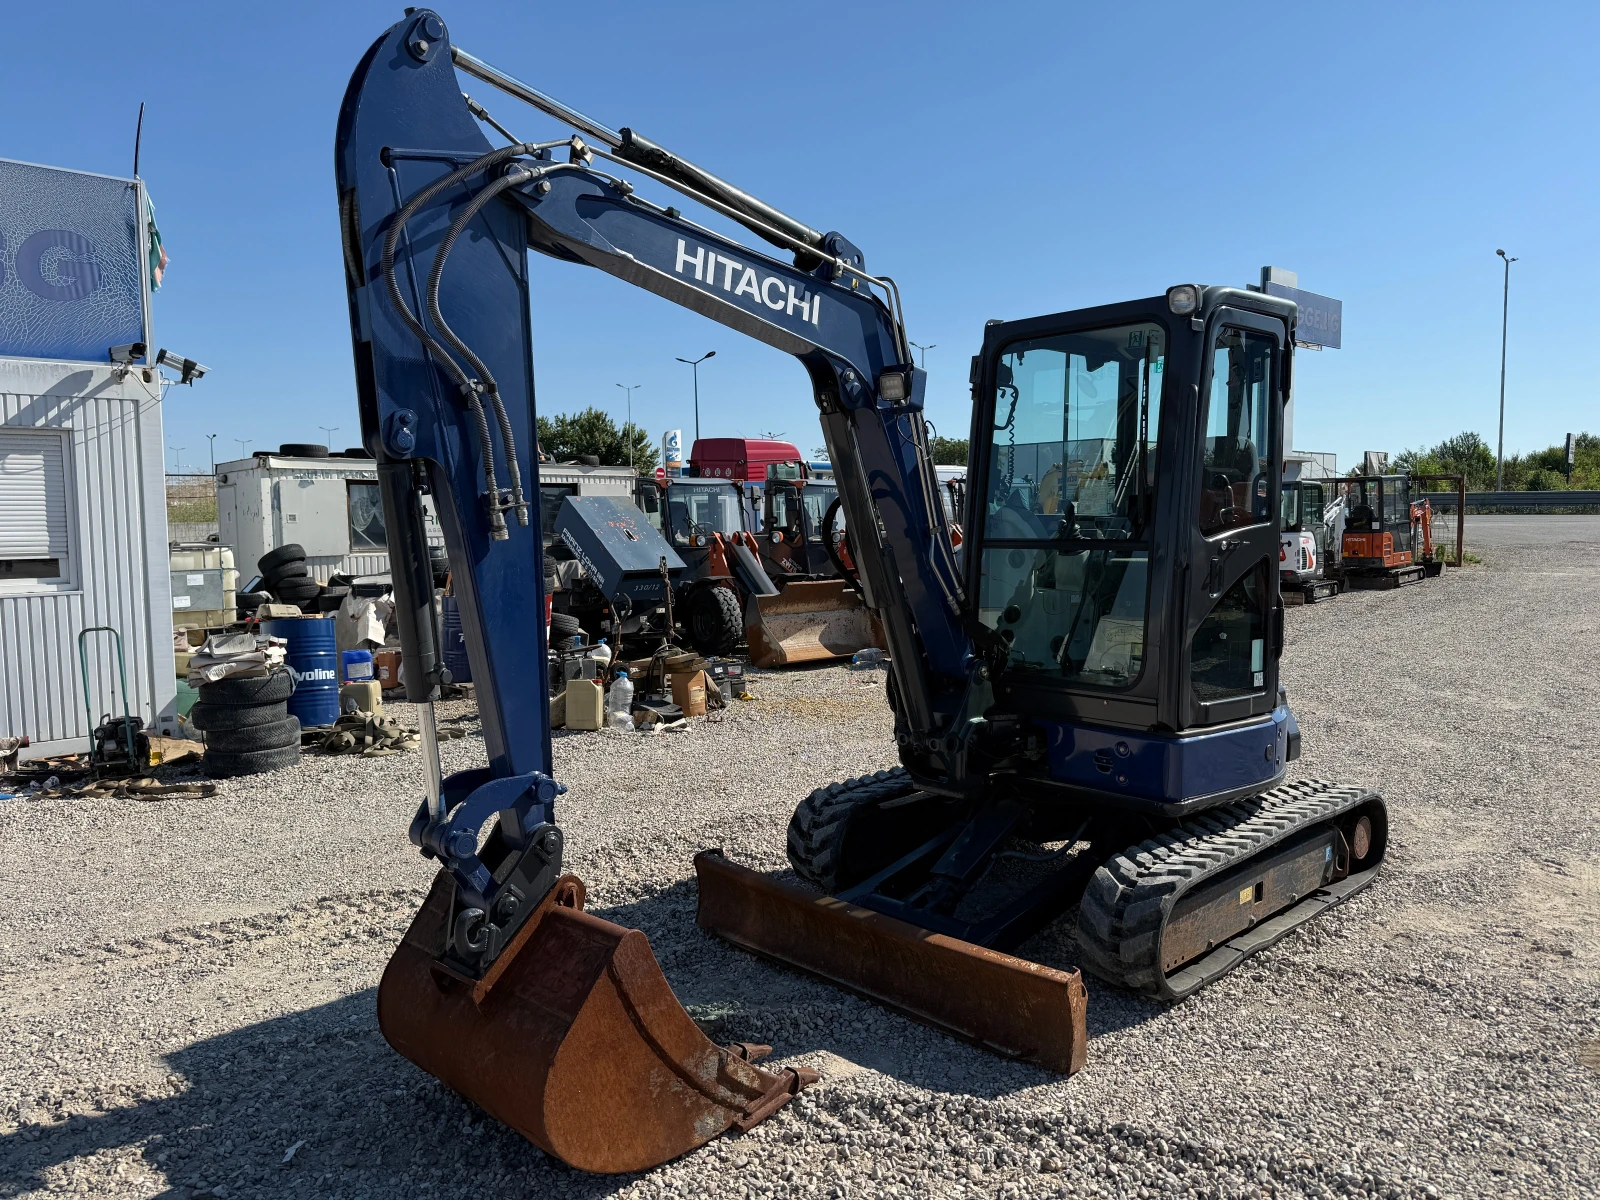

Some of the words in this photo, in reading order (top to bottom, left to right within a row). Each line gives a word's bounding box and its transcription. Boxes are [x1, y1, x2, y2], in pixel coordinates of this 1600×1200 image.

[0, 229, 100, 301] G
[675, 238, 821, 326] HITACHI
[296, 668, 335, 681] voline
